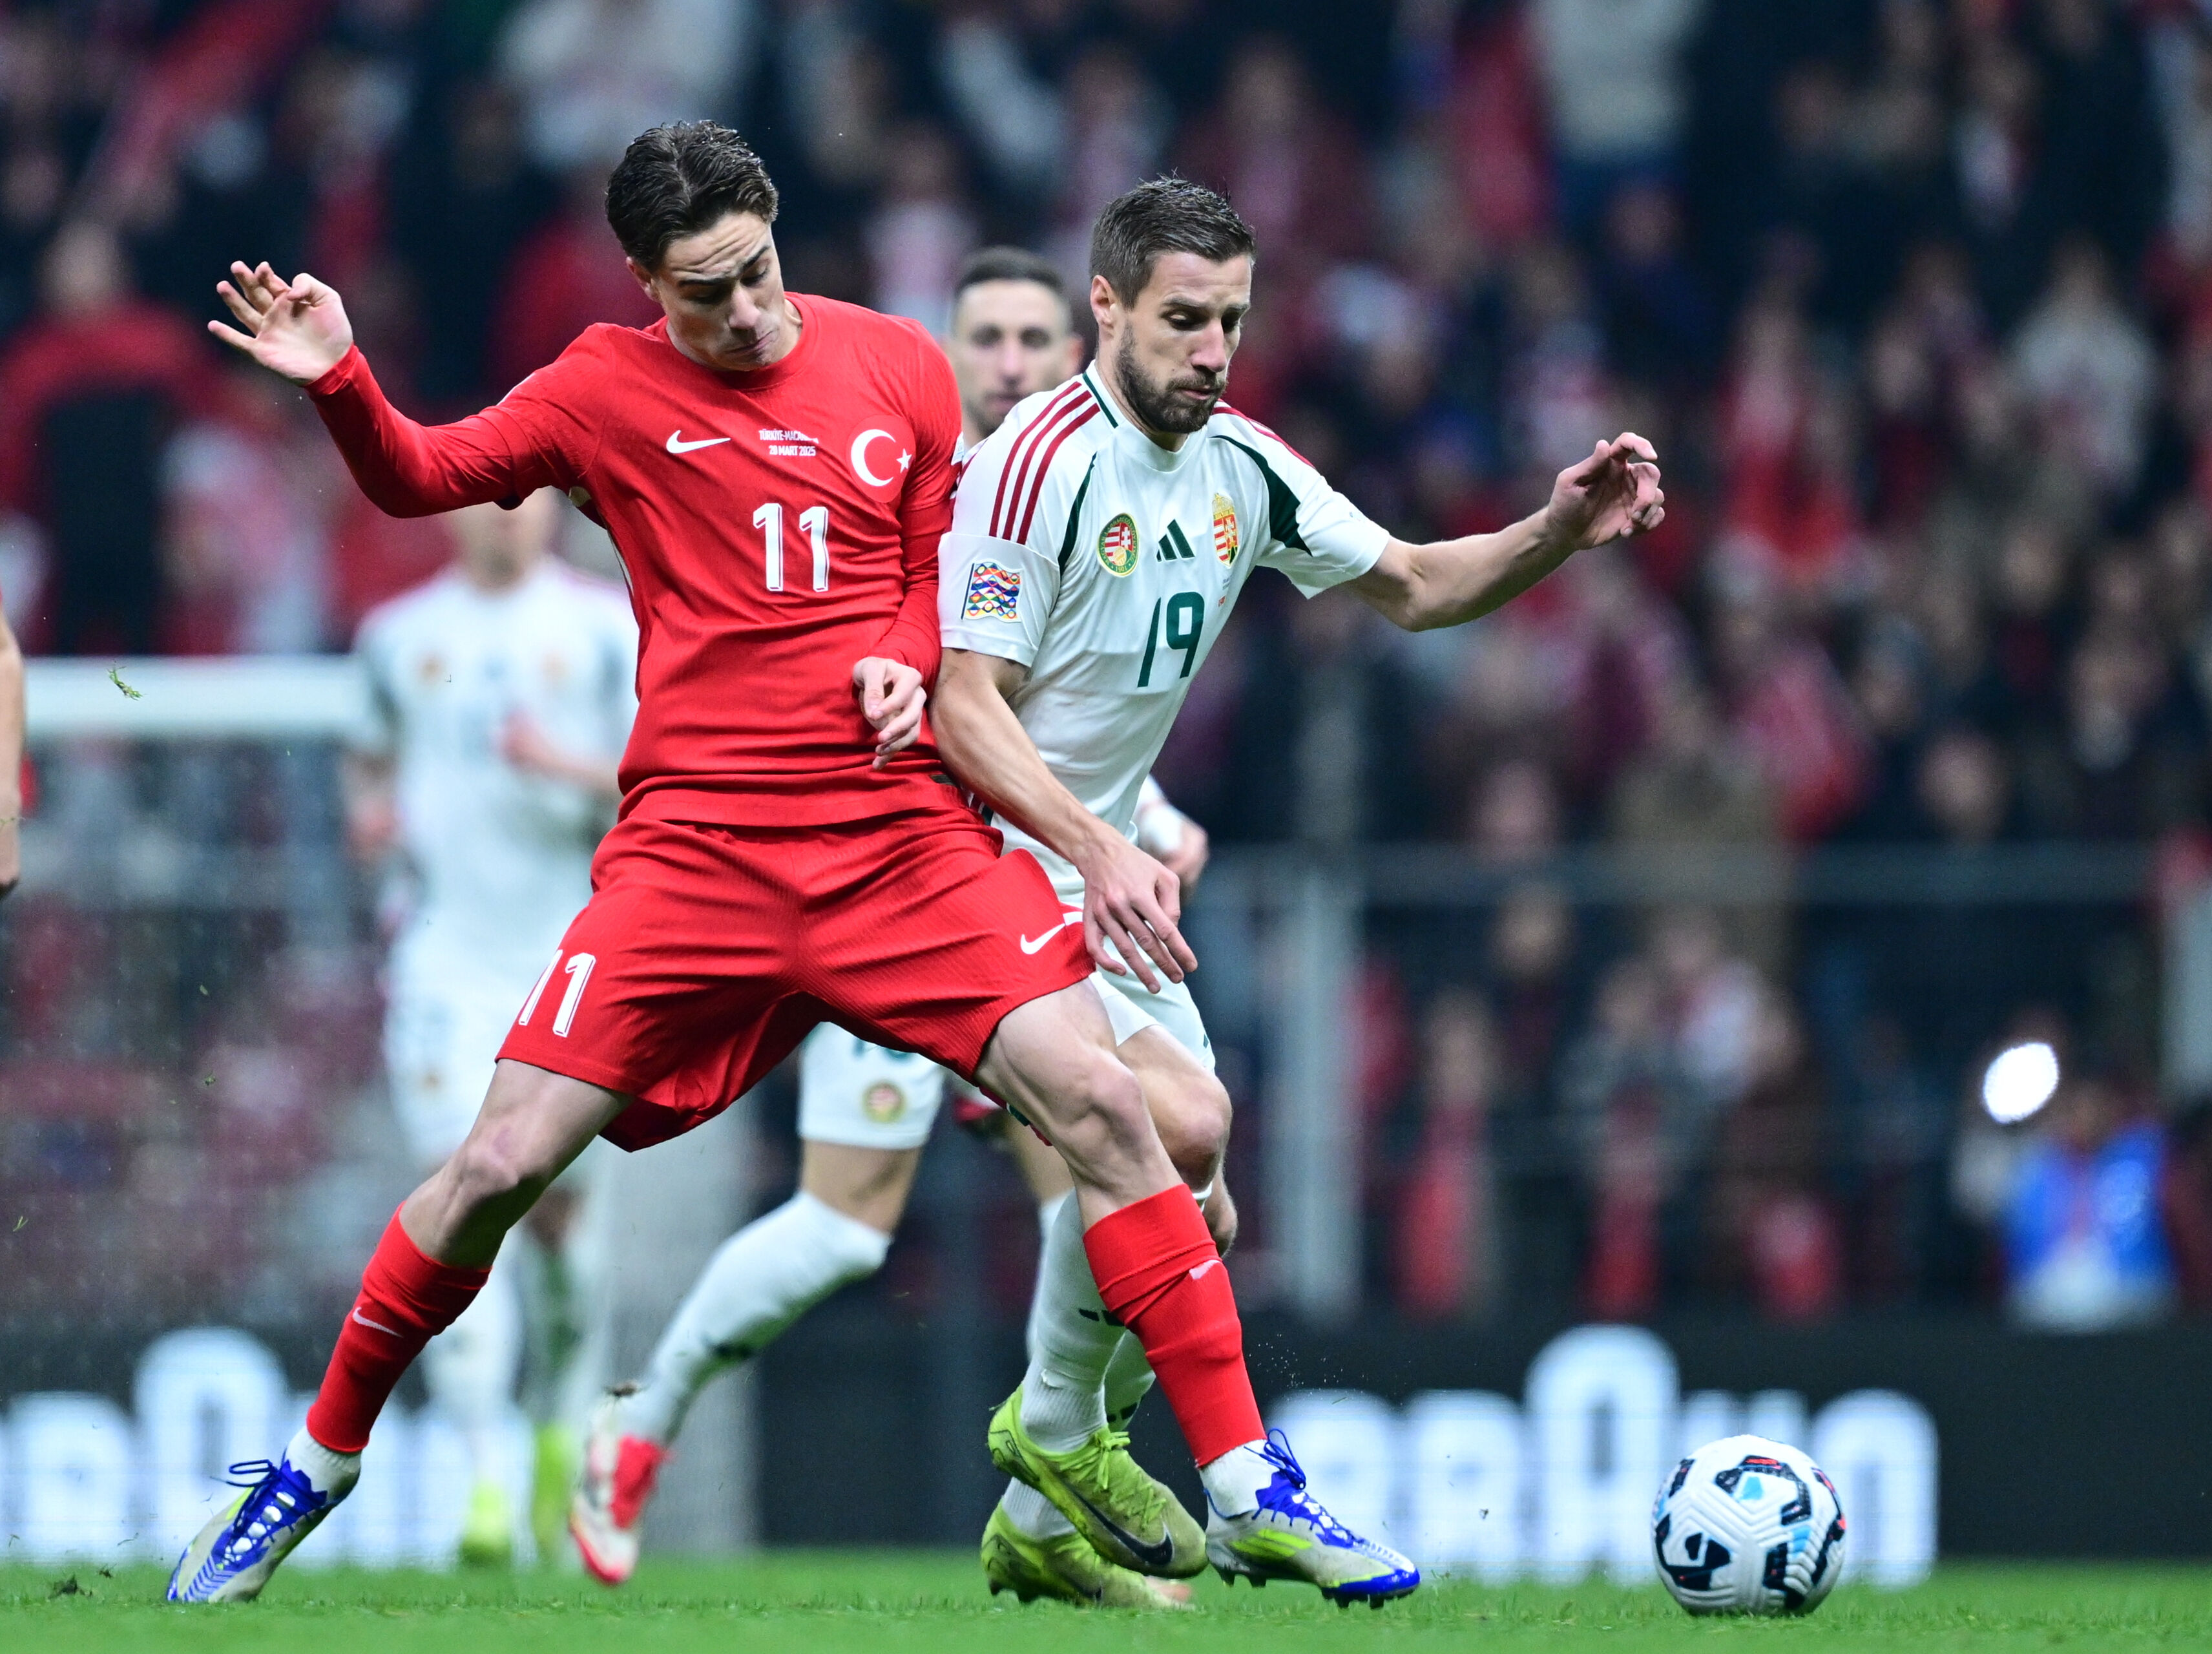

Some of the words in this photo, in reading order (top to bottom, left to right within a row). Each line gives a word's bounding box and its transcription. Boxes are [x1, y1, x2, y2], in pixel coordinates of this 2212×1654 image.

[778, 446, 798, 455] MART
[798, 446, 816, 456] 2025
[753, 503, 829, 592] 11
[1136, 591, 1205, 688] 19
